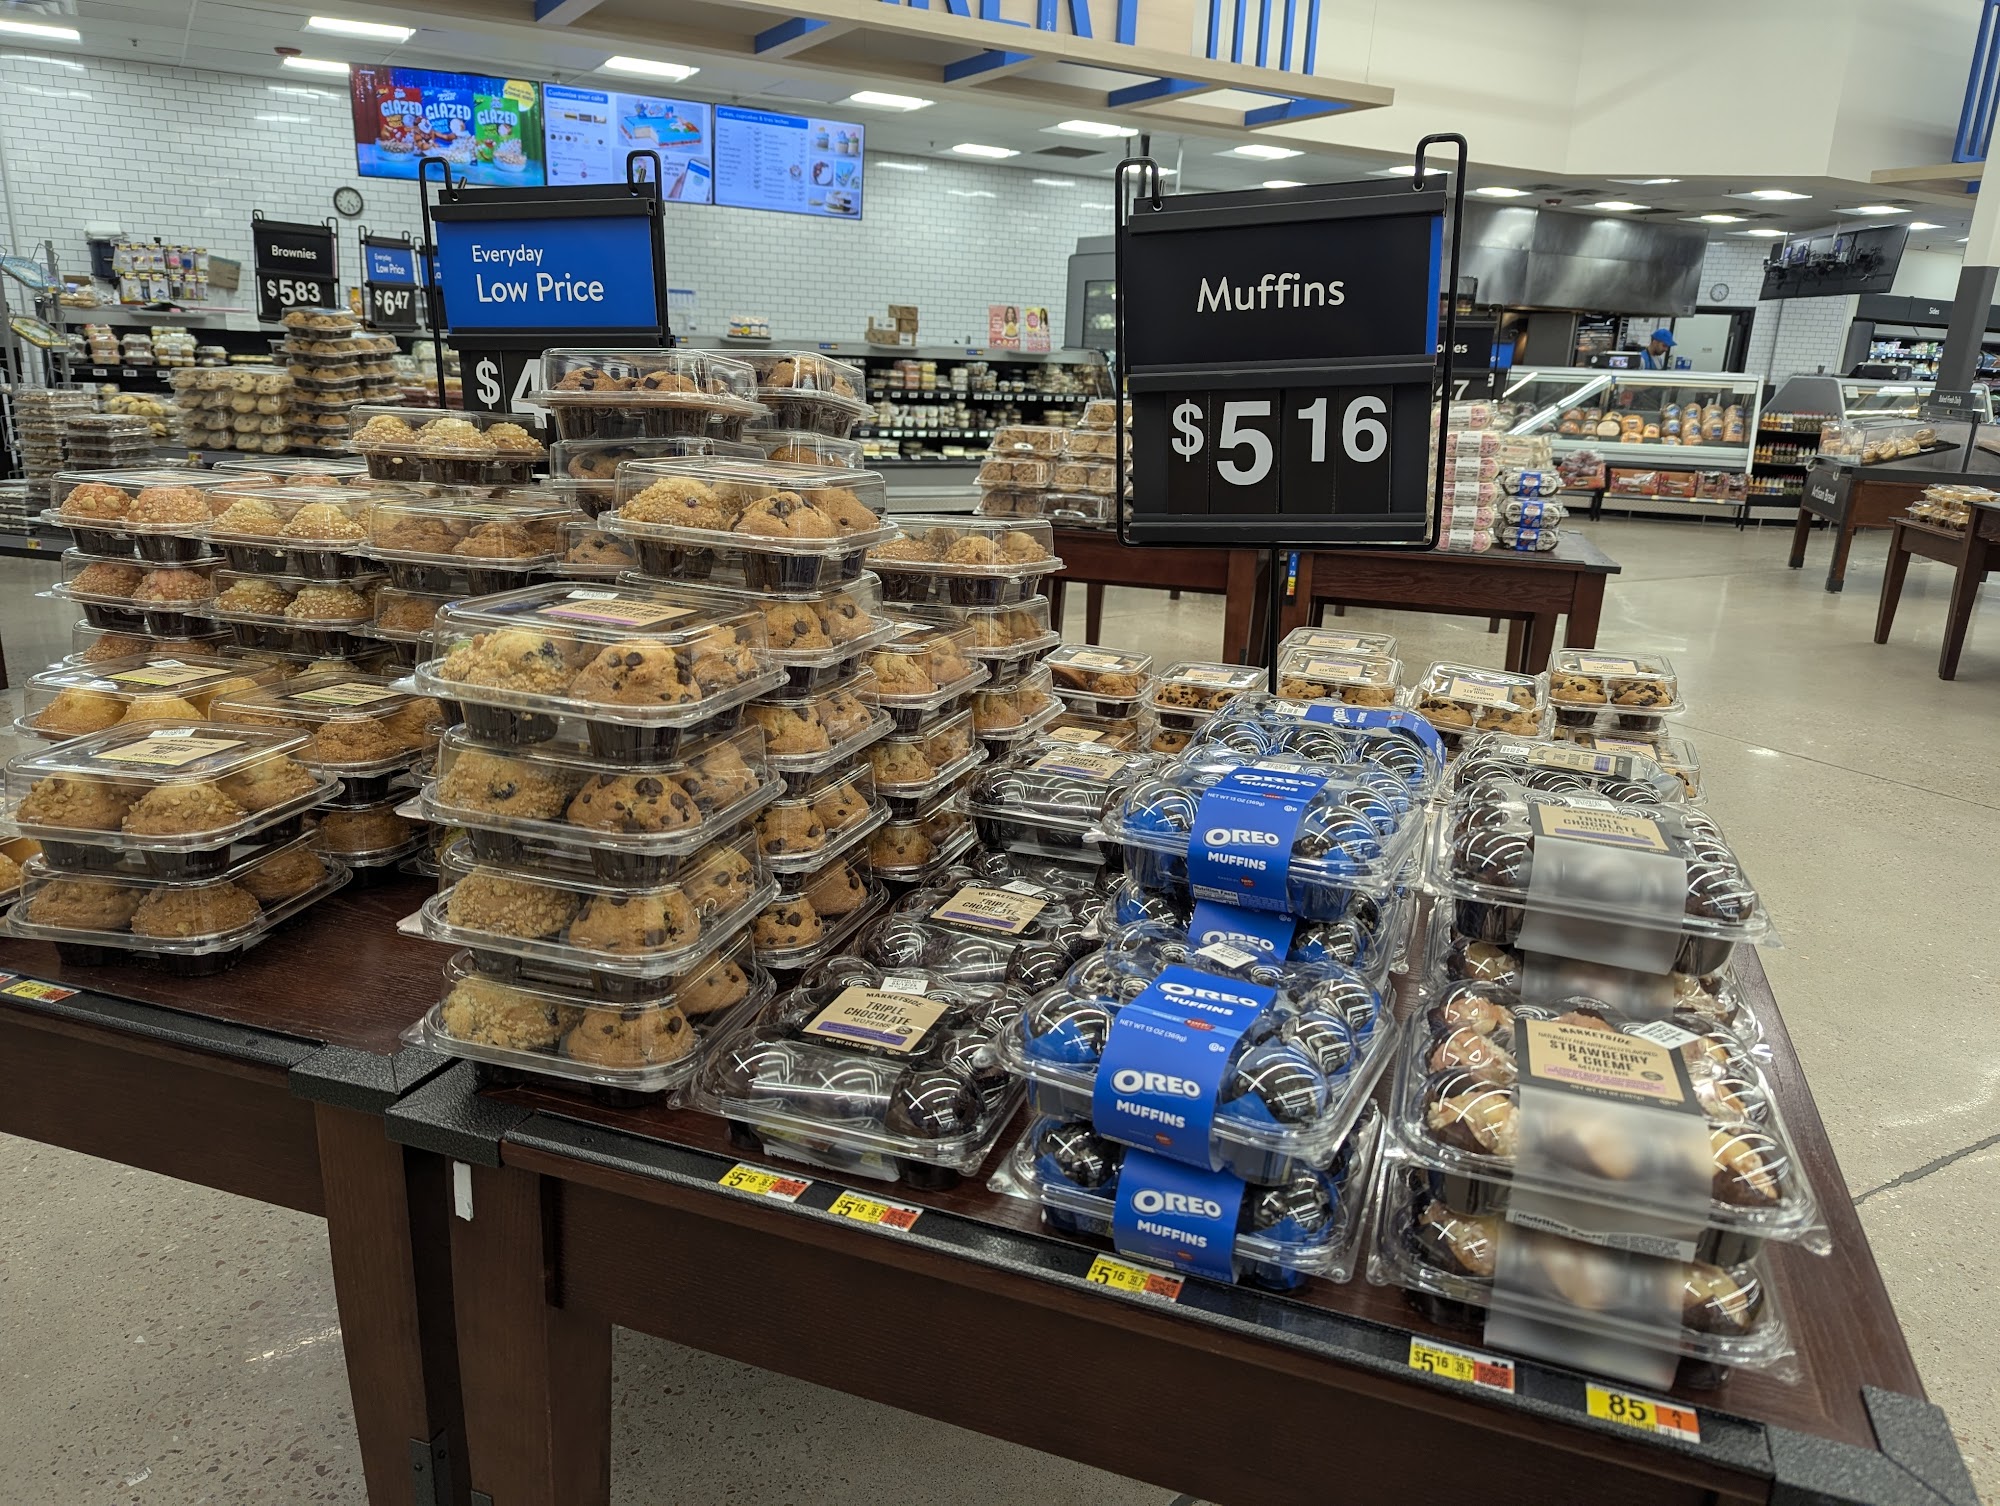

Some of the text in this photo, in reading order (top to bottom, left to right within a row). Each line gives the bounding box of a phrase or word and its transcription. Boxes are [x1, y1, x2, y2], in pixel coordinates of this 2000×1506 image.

[381, 100, 422, 116] GLAZED
[425, 102, 472, 121] GLAZED
[477, 108, 518, 126] GLAZED
[271, 244, 317, 260] Brownies
[374, 252, 392, 263] Everyday
[472, 244, 543, 267] Everyday
[375, 262, 406, 275] Low Price
[476, 272, 604, 302] Low Price
[1197, 272, 1346, 312] Muffins
[1928, 307, 1940, 316] Sides
[1812, 485, 1836, 505] Artisan Bread
[1231, 774, 1317, 787] OREO
[1240, 780, 1298, 792] MUFFINS
[1563, 819, 1638, 833] CHOCOLATE
[1577, 816, 1619, 826] TRIPLE
[1204, 828, 1280, 846] OREO
[1208, 852, 1266, 871] MUFFINS
[866, 992, 926, 1008] MARKETSIDE
[1158, 982, 1259, 1008] OREO
[866, 1001, 907, 1015] TRIPLE
[1164, 994, 1234, 1016] MUFFINS
[844, 1007, 912, 1026] CHOCOLATE
[851, 1018, 892, 1028] MUFFINS
[1119, 1018, 1132, 1027] NET
[1134, 1023, 1145, 1031] WT
[1154, 1028, 1164, 1036] OZ
[1559, 1027, 1632, 1045] MARKETSIDE
[1549, 1040, 1649, 1065] STRAWBERRY
[1568, 1053, 1635, 1072] & CREME
[1578, 1064, 1629, 1077] MUFFINS
[1112, 1069, 1200, 1098] OREO
[1116, 1099, 1186, 1128] MUFFINS
[1134, 1190, 1221, 1218] OREO
[1137, 1219, 1207, 1248] MUFFINS
[1517, 1213, 1603, 1240] Nutrition Facts
[1608, 1394, 1646, 1421] 85
